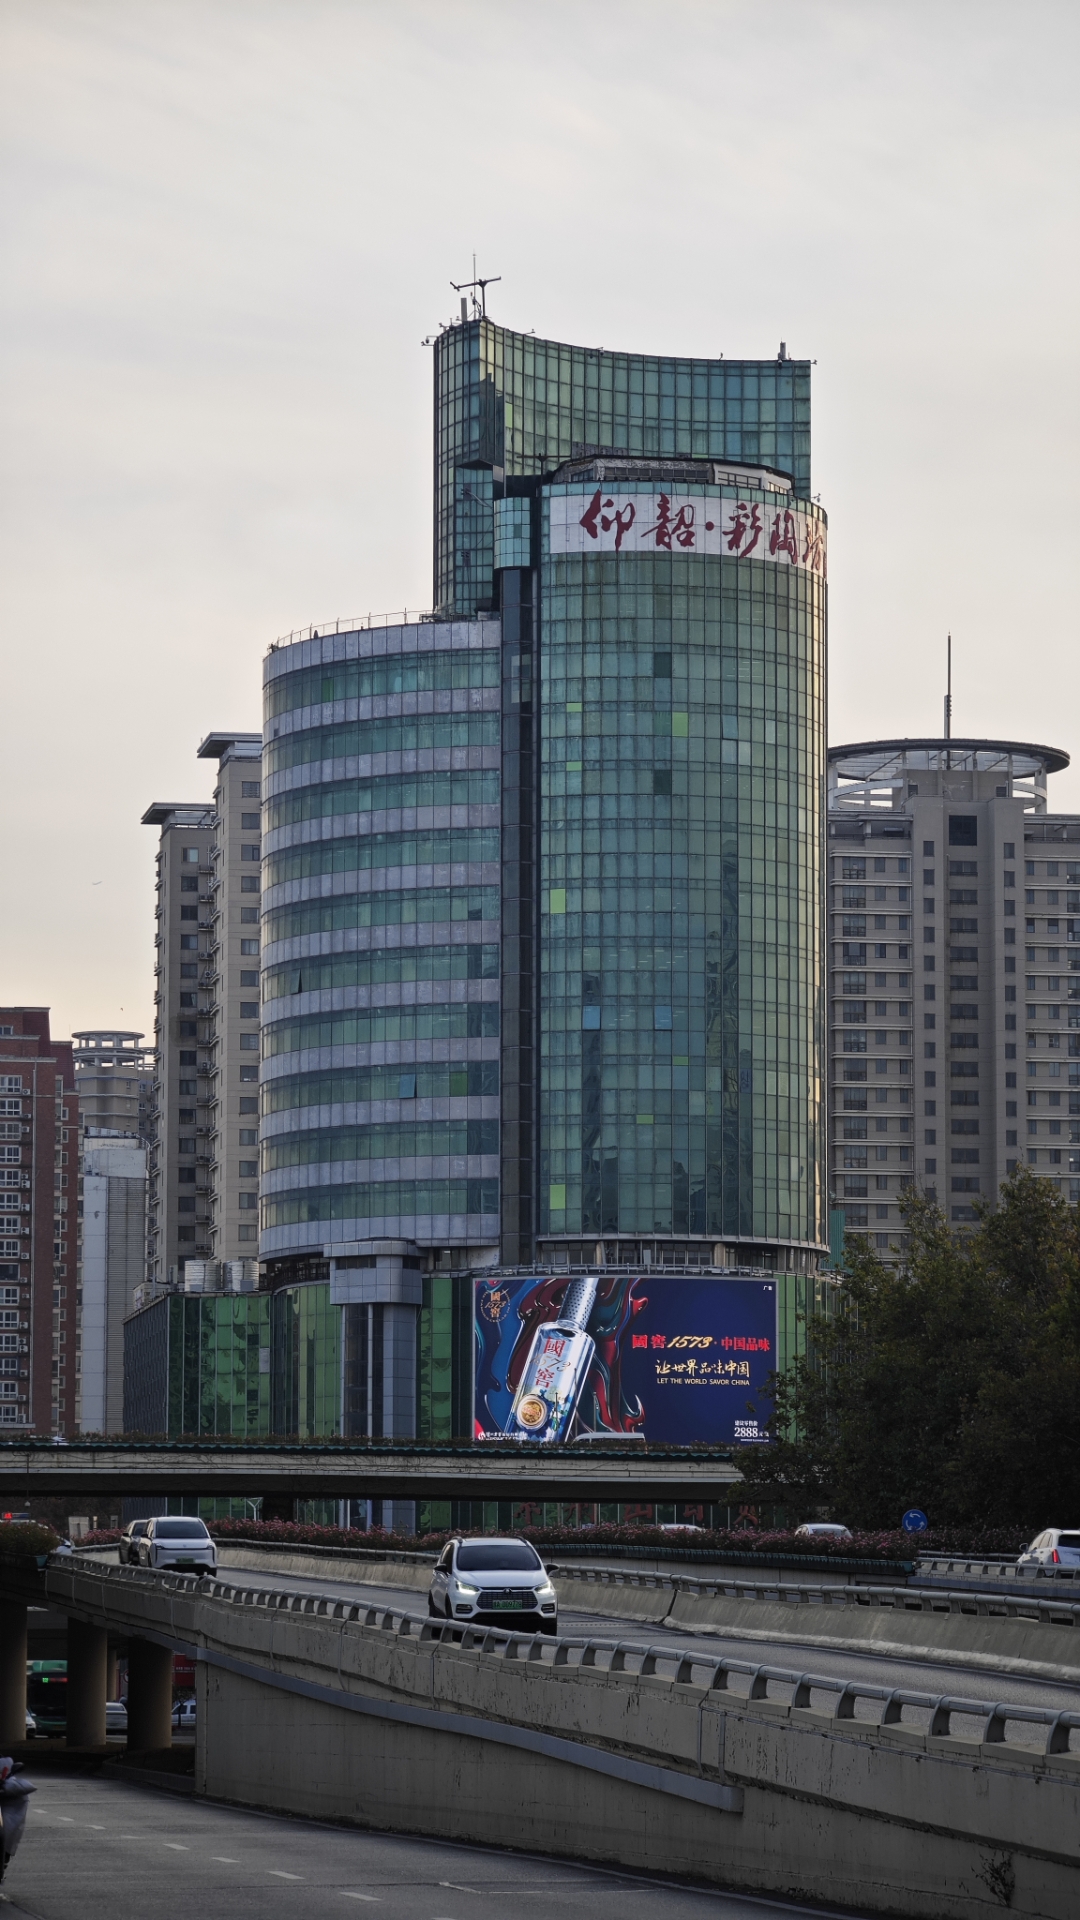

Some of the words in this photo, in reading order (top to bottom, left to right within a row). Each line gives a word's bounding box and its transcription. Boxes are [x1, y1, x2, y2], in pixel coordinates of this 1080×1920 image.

[655, 1359, 750, 1377] 让世界品味中国
[734, 1427, 758, 1438] 2888
